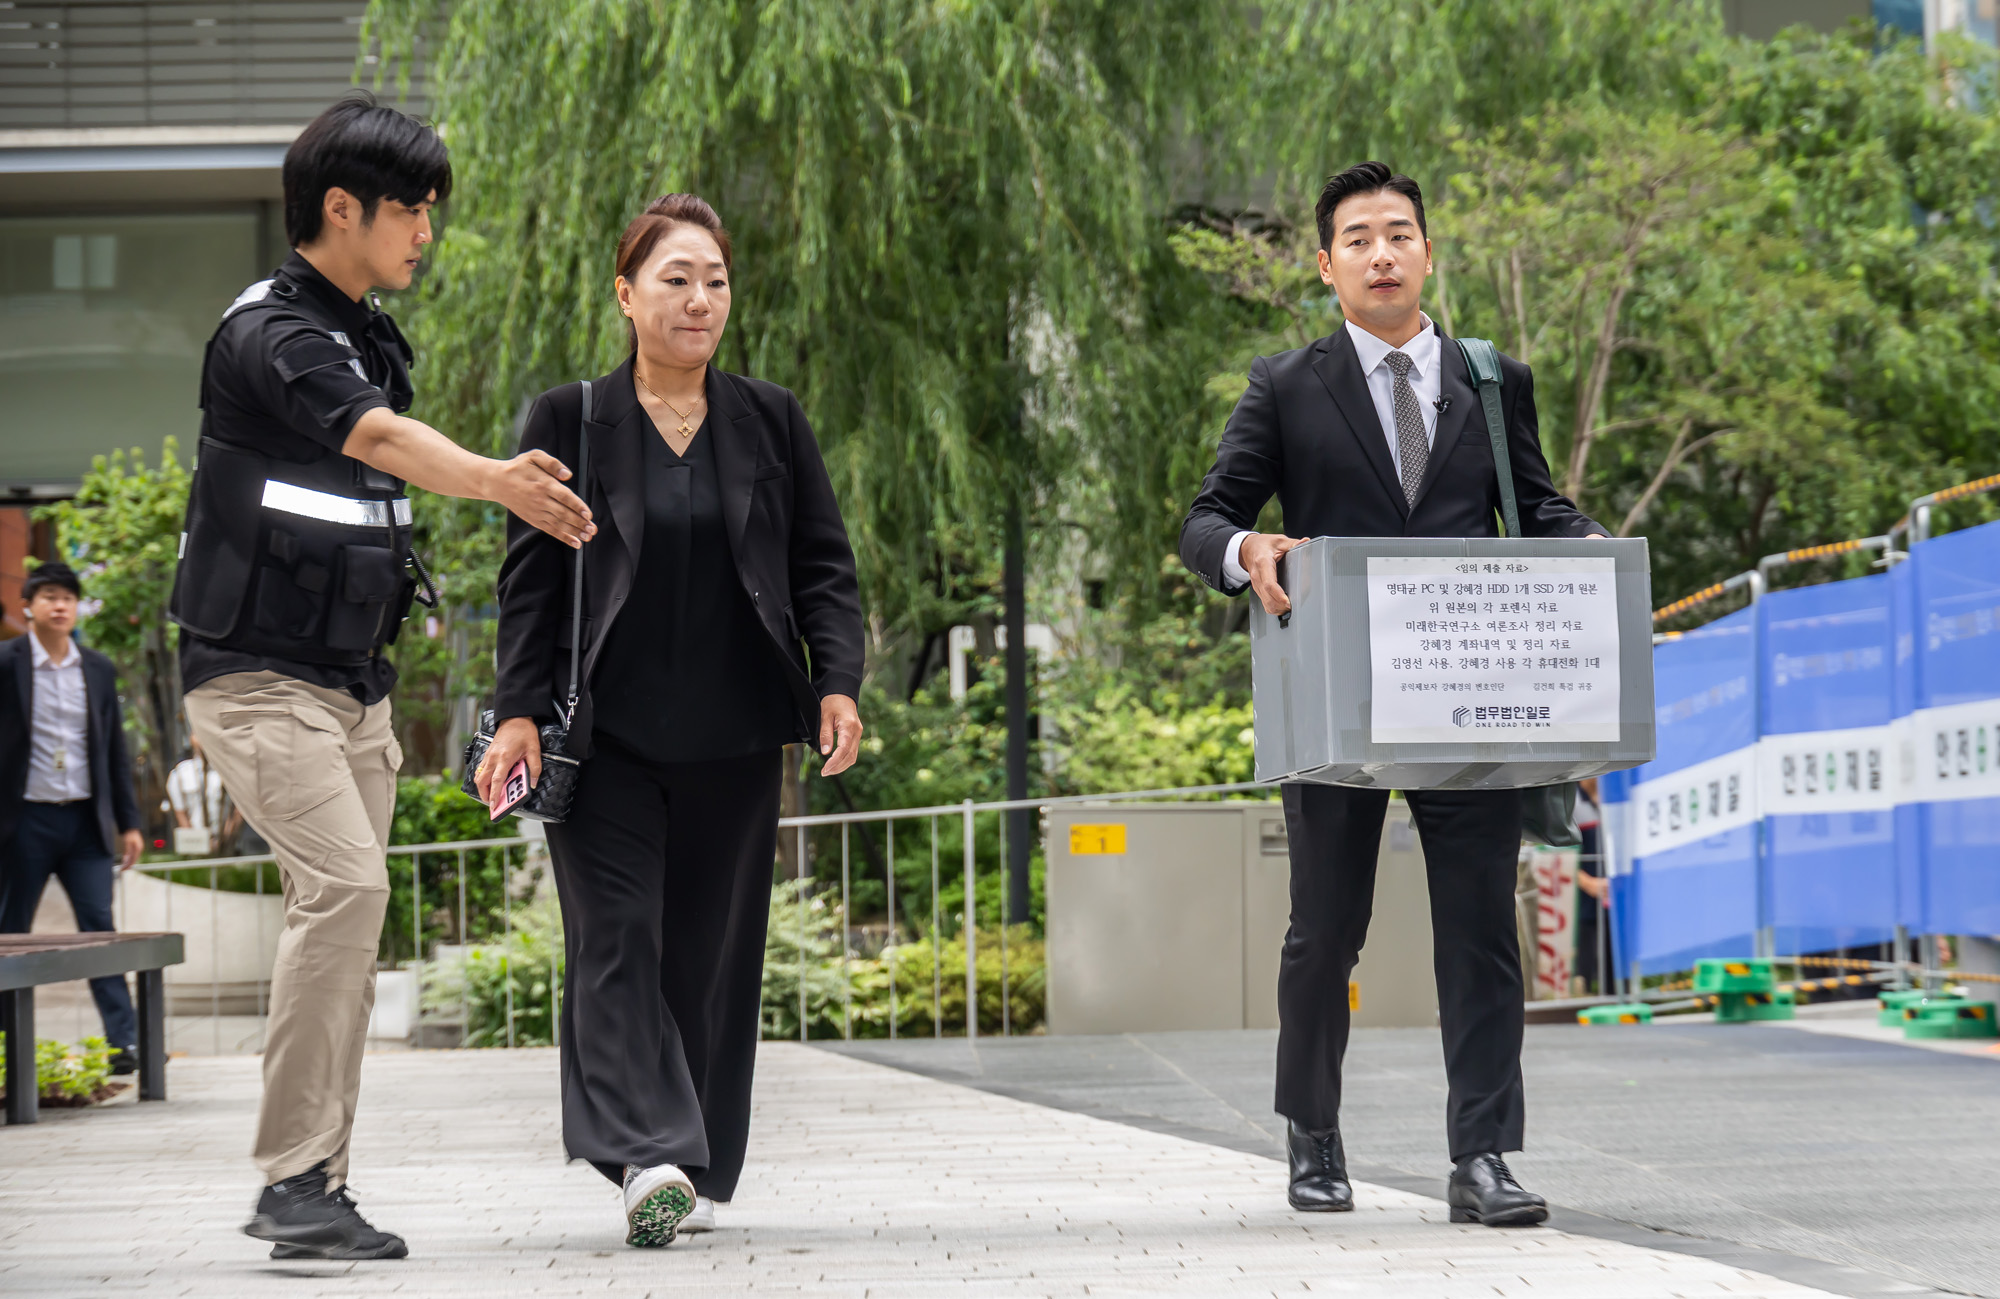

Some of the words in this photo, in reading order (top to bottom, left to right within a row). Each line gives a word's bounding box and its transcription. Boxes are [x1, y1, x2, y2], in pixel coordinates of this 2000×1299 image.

[1455, 563, 1478, 574] <임의
[1483, 563, 1501, 574] 제출
[1505, 563, 1529, 574] 자료>
[1386, 583, 1417, 596] 명태균
[1421, 583, 1435, 594] PC
[1439, 583, 1449, 596] 및
[1453, 583, 1483, 596] 강혜경
[1487, 583, 1510, 594] HDD
[1514, 583, 1530, 595] 1개
[1533, 583, 1555, 594] SSD
[1558, 583, 1574, 595] 2개
[1578, 583, 1598, 595] 원본
[1429, 601, 1439, 614] 위
[1445, 601, 1477, 614] 원본의
[1483, 601, 1494, 614] 각
[1499, 601, 1531, 614] 포렌식
[1536, 601, 1559, 614] 자료
[1405, 620, 1481, 633] 미래한국연구소
[1486, 620, 1529, 633] 여론조사
[1535, 620, 1556, 633] 정리
[1561, 620, 1584, 632] 자료
[1420, 638, 1452, 651] 강혜경
[1458, 638, 1500, 651] 계좌내역
[1506, 638, 1517, 651] 및
[1522, 638, 1544, 651] 정리
[1549, 638, 1572, 651] 자료
[1391, 657, 1423, 670] 김영선
[1458, 657, 1490, 670] 강혜경
[1495, 657, 1517, 670] 사용
[1522, 657, 1533, 669] 각
[1537, 657, 1579, 669] 휴대전화
[1584, 657, 1600, 669] 1대
[1400, 682, 1437, 692] 공익제보자
[1441, 682, 1471, 692] 강혜경의
[1475, 682, 1505, 692] 변호인단
[1533, 682, 1555, 692] 김건희
[1475, 706, 1551, 720] 법무법인일로
